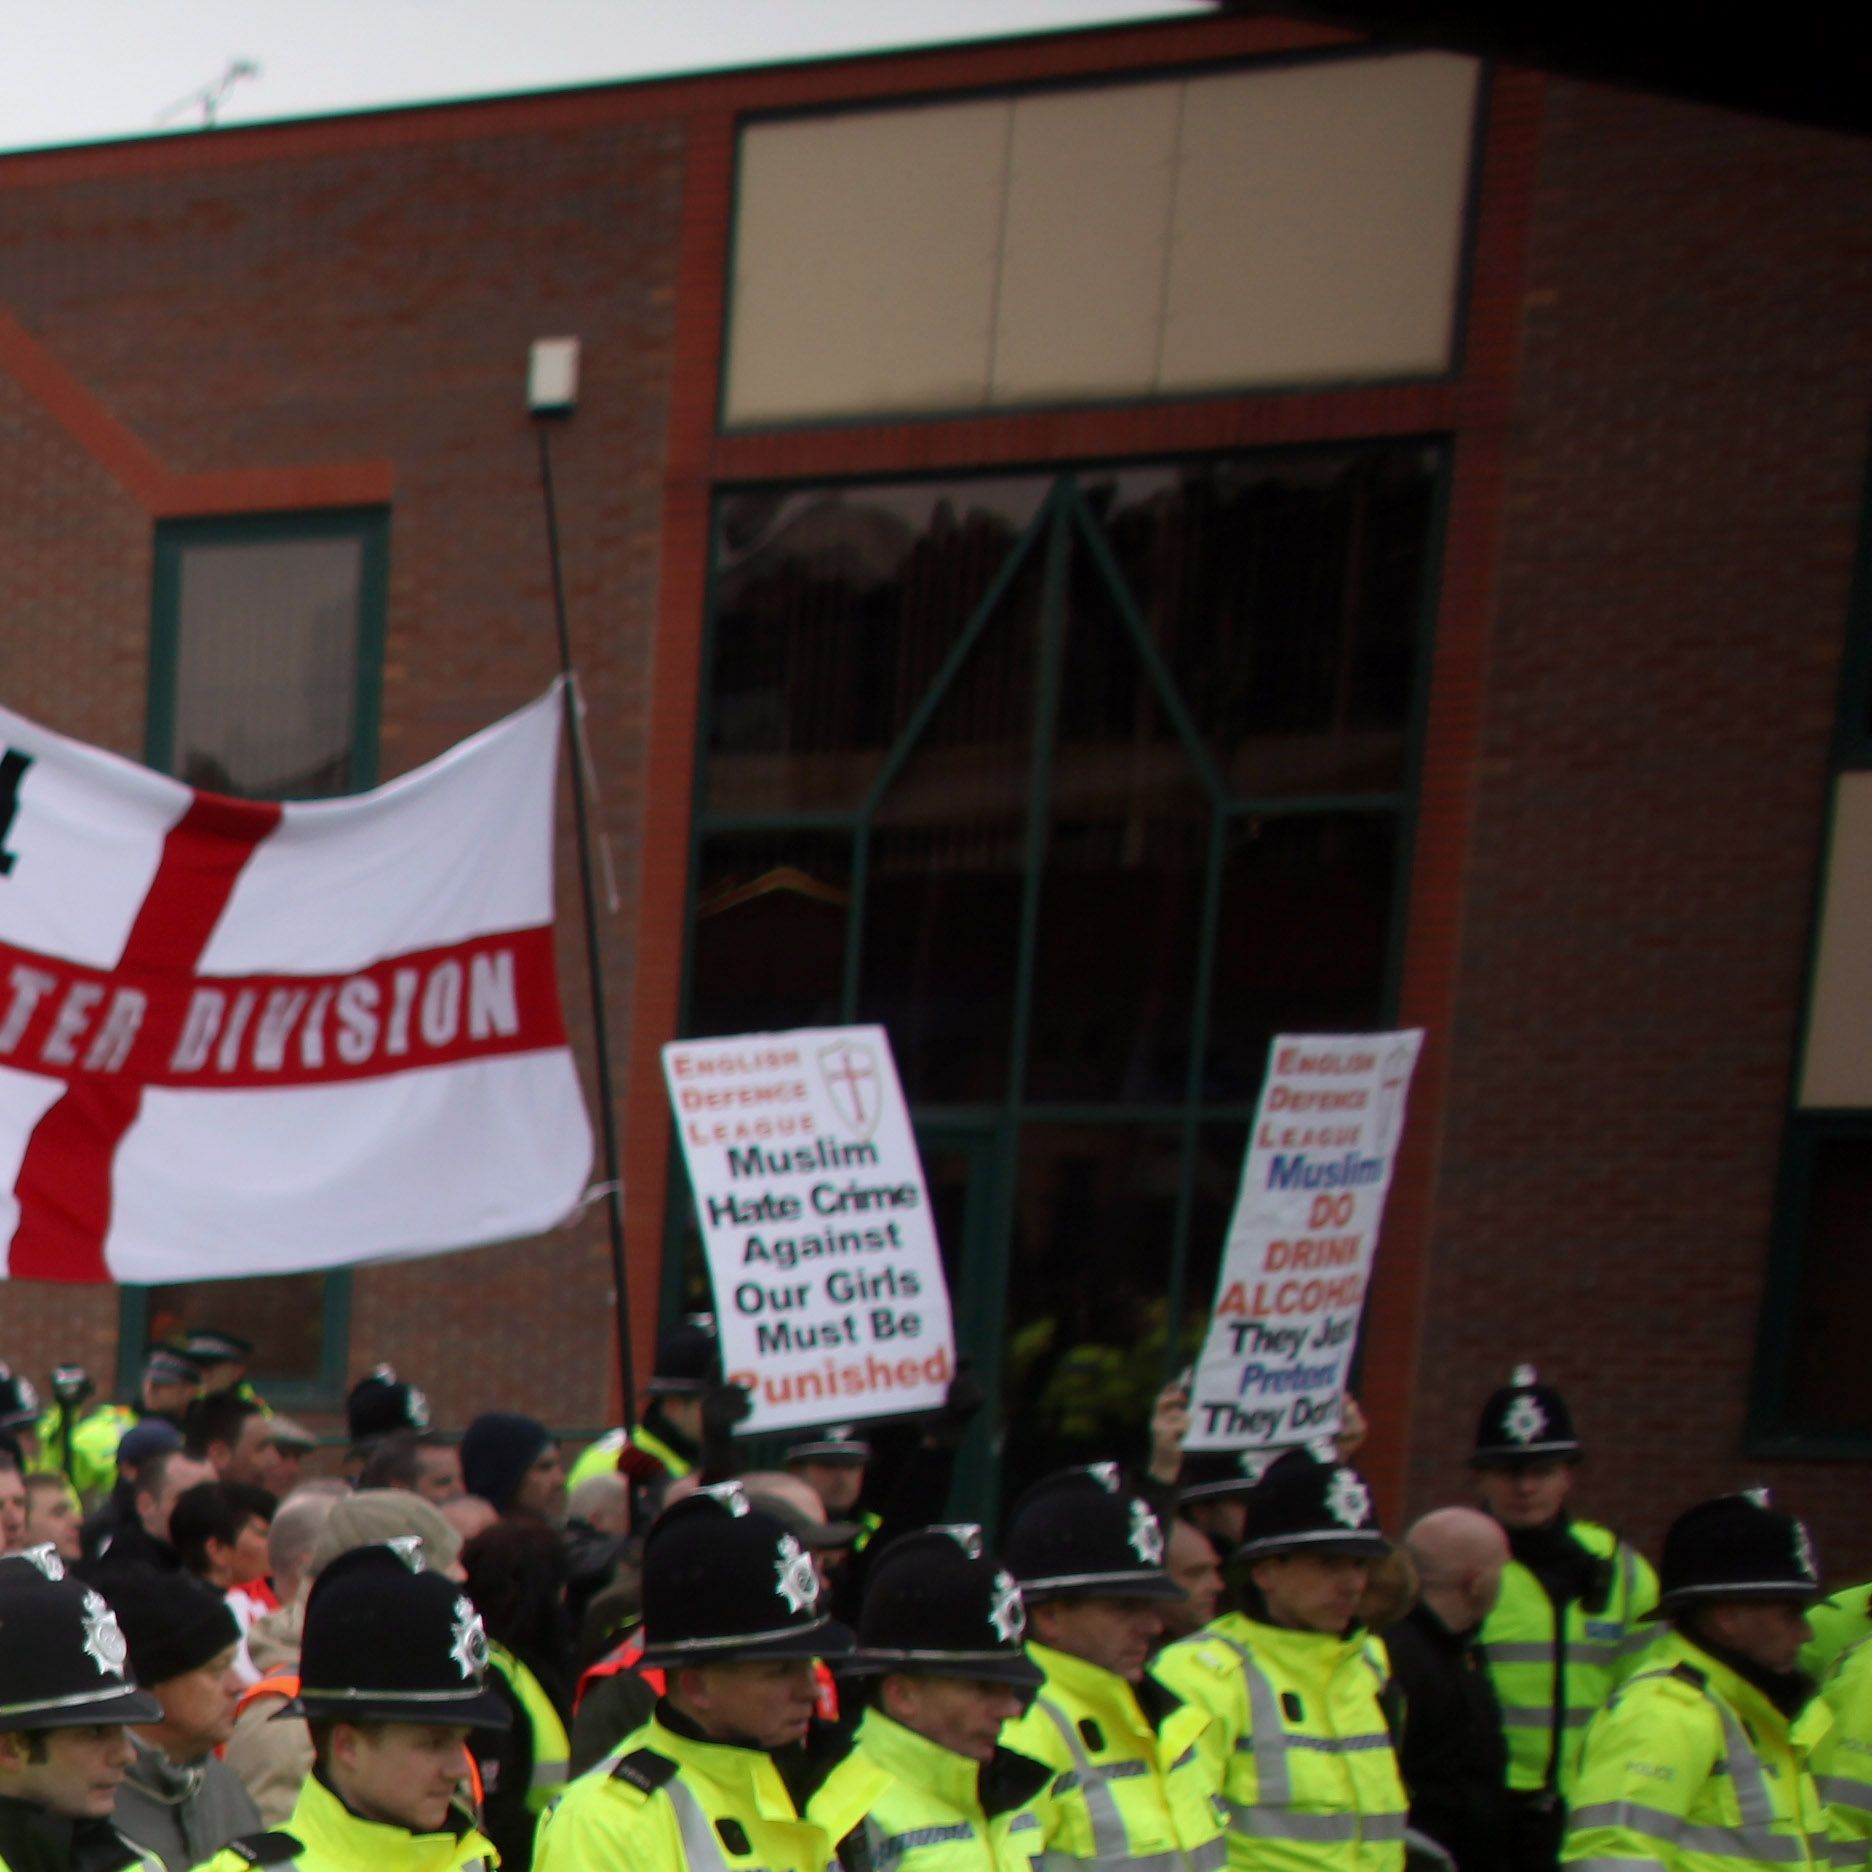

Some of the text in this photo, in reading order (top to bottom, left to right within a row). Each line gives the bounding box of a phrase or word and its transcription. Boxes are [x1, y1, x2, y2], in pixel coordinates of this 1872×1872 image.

[170, 950, 519, 1073] DIVISION
[728, 1139, 878, 1179] Muslim
[709, 1182, 919, 1229] Hate Crime
[1309, 1195, 1355, 1230] DO
[744, 1223, 902, 1269] Against
[734, 1265, 921, 1315] Our Girls
[756, 1308, 921, 1355] Must Be
[1229, 1322, 1309, 1360] They
[1202, 1404, 1285, 1441] They
